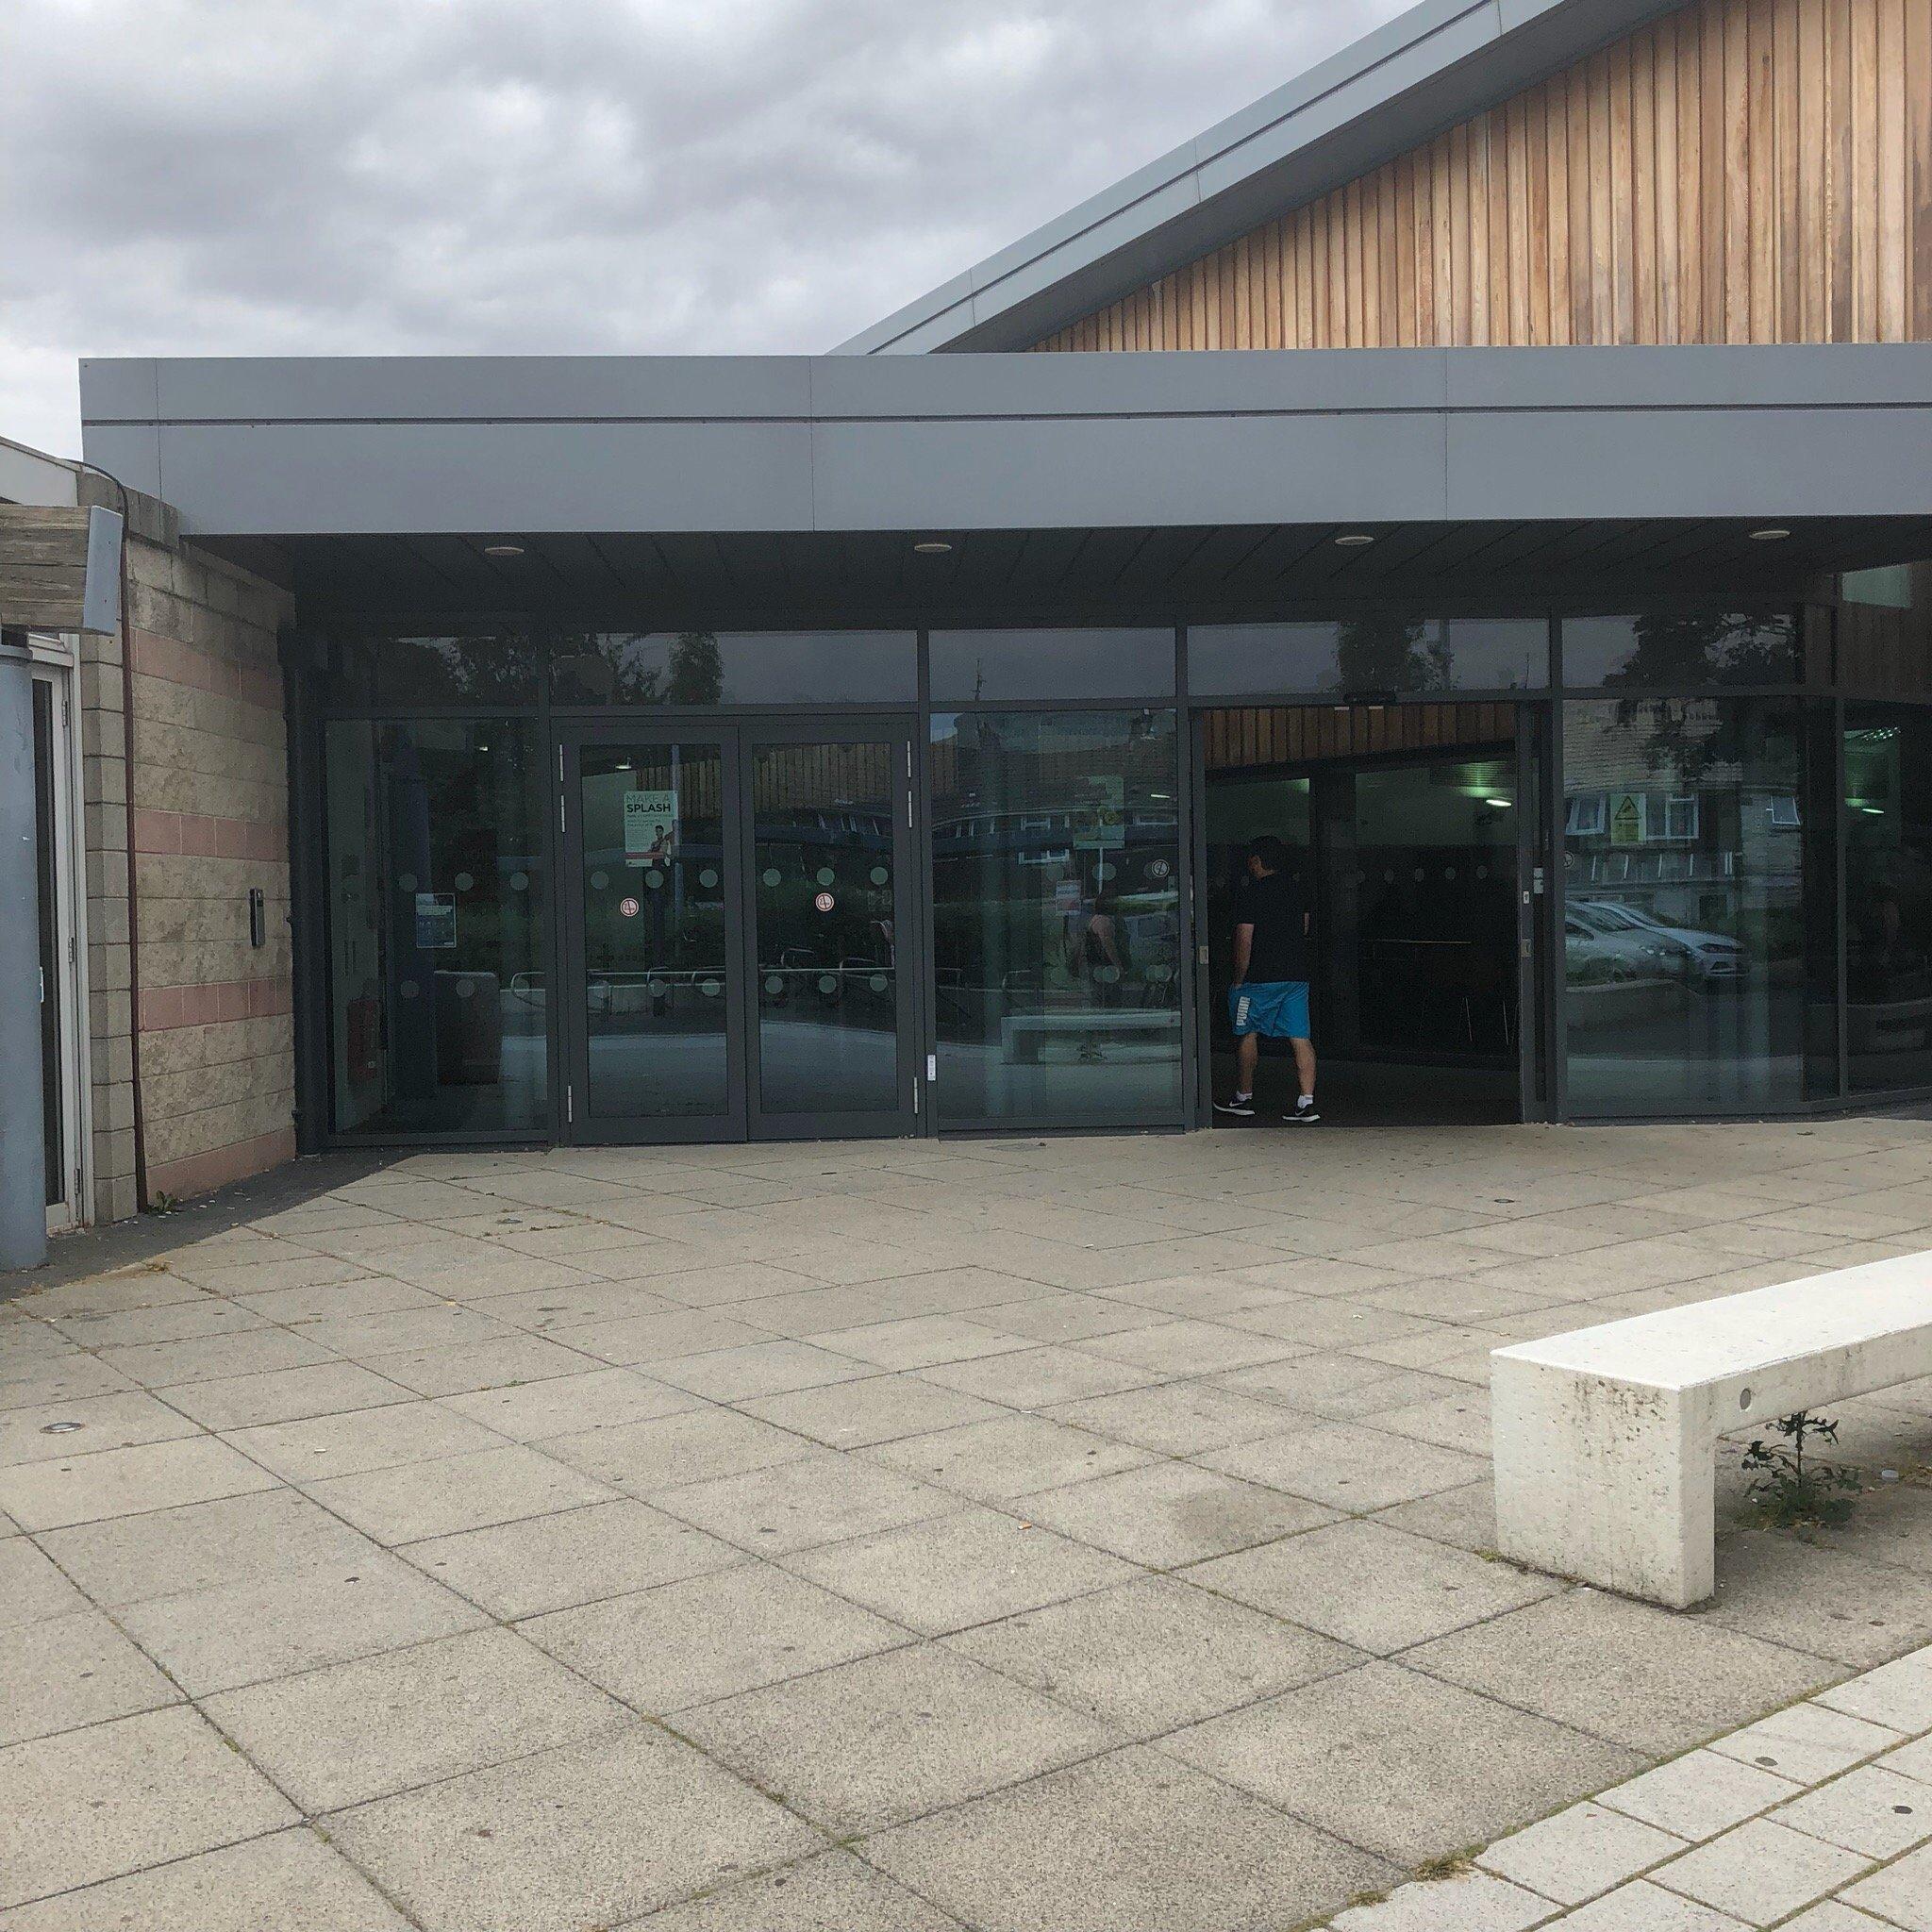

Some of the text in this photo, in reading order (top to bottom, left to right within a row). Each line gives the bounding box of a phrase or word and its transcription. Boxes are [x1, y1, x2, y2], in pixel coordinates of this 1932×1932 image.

[626, 794, 671, 803] MAKE A
[626, 803, 671, 812] SPLASH
[1236, 996, 1251, 1026] PUMA
